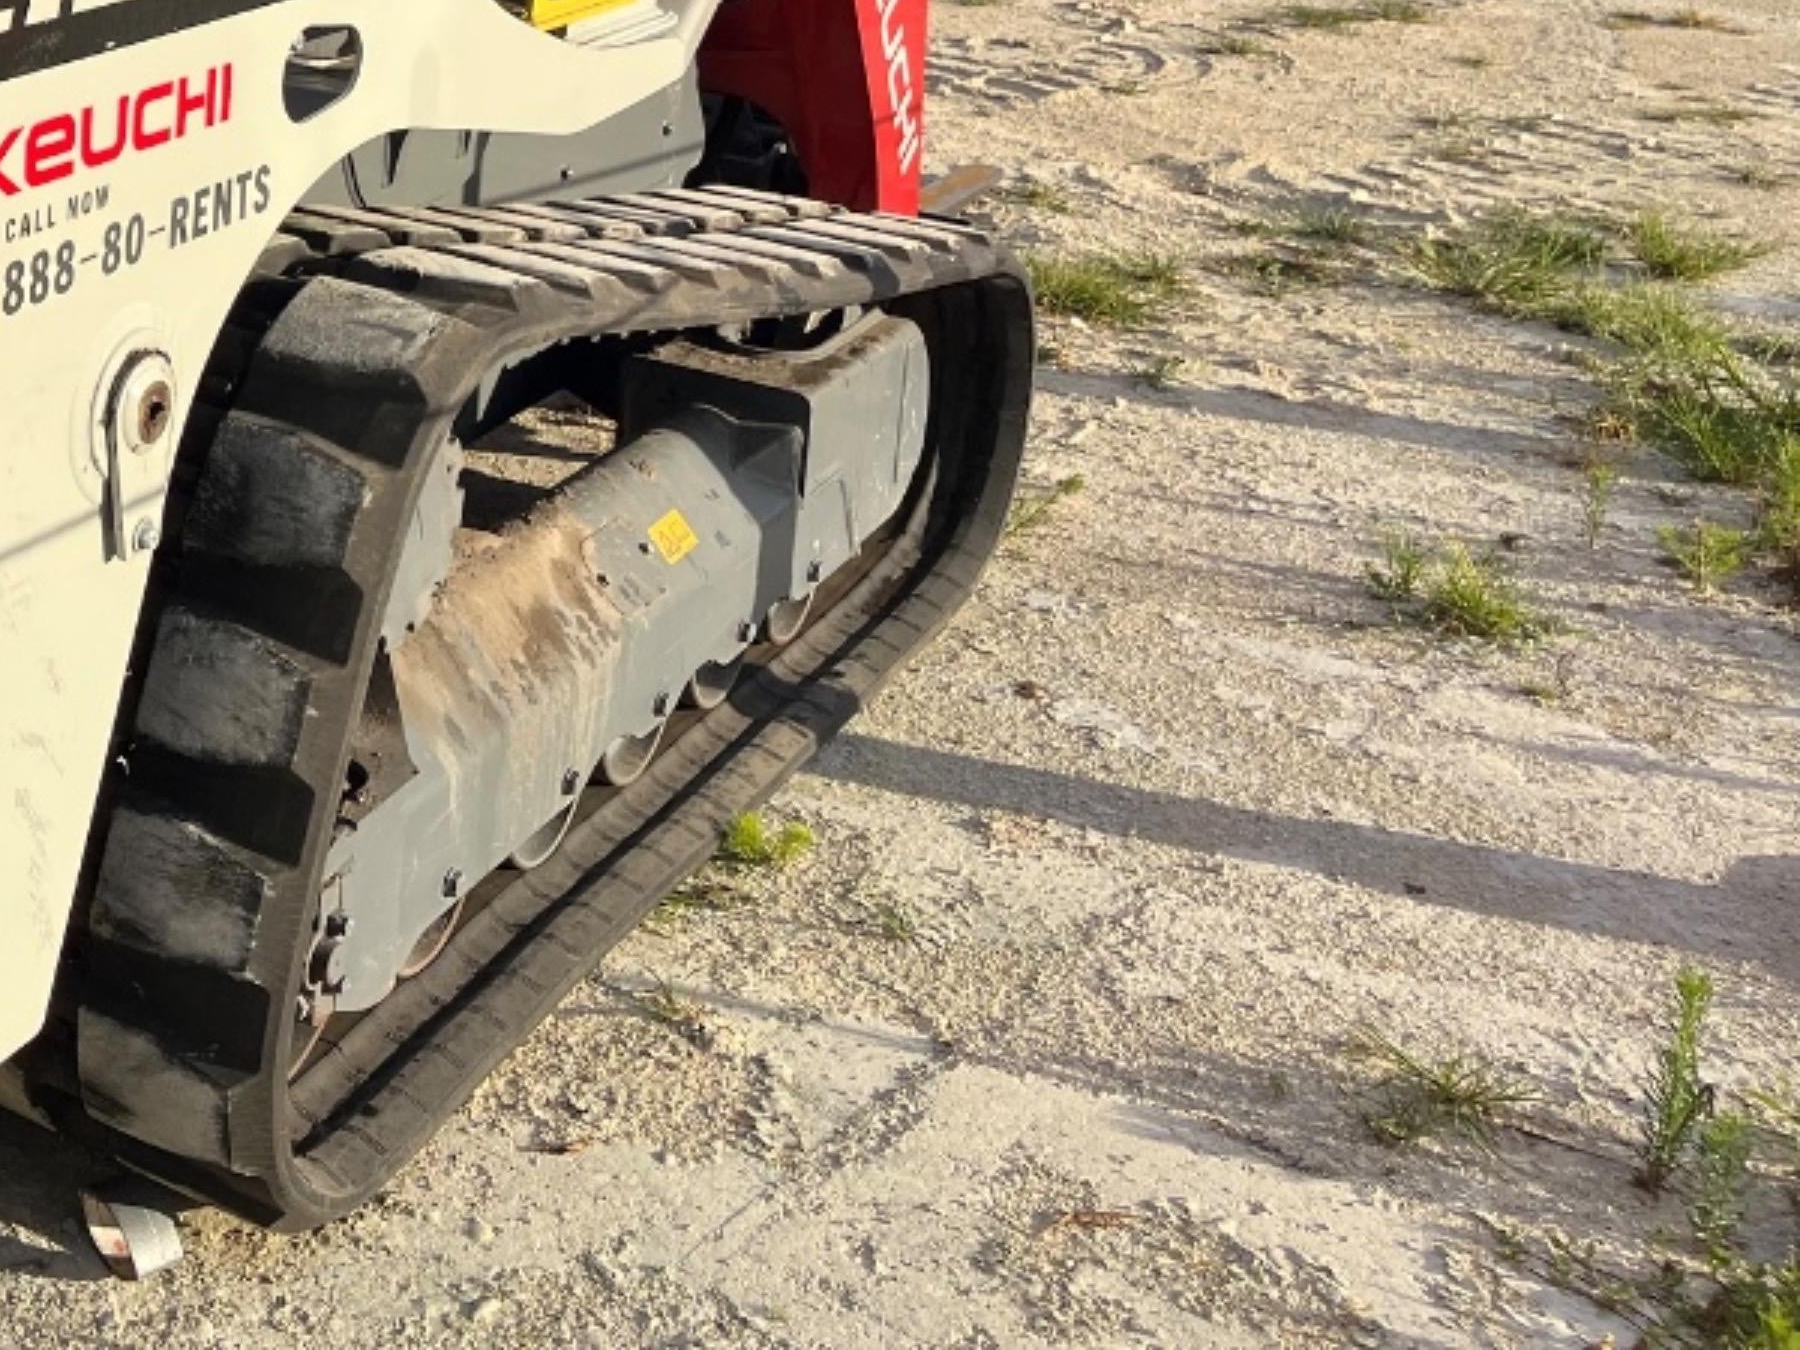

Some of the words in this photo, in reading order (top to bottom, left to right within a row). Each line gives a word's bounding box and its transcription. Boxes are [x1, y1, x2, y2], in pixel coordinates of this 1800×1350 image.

[2, 163, 272, 316] 888-80-RENTS
[5, 202, 56, 243] CALL
[66, 184, 110, 220] NOW
